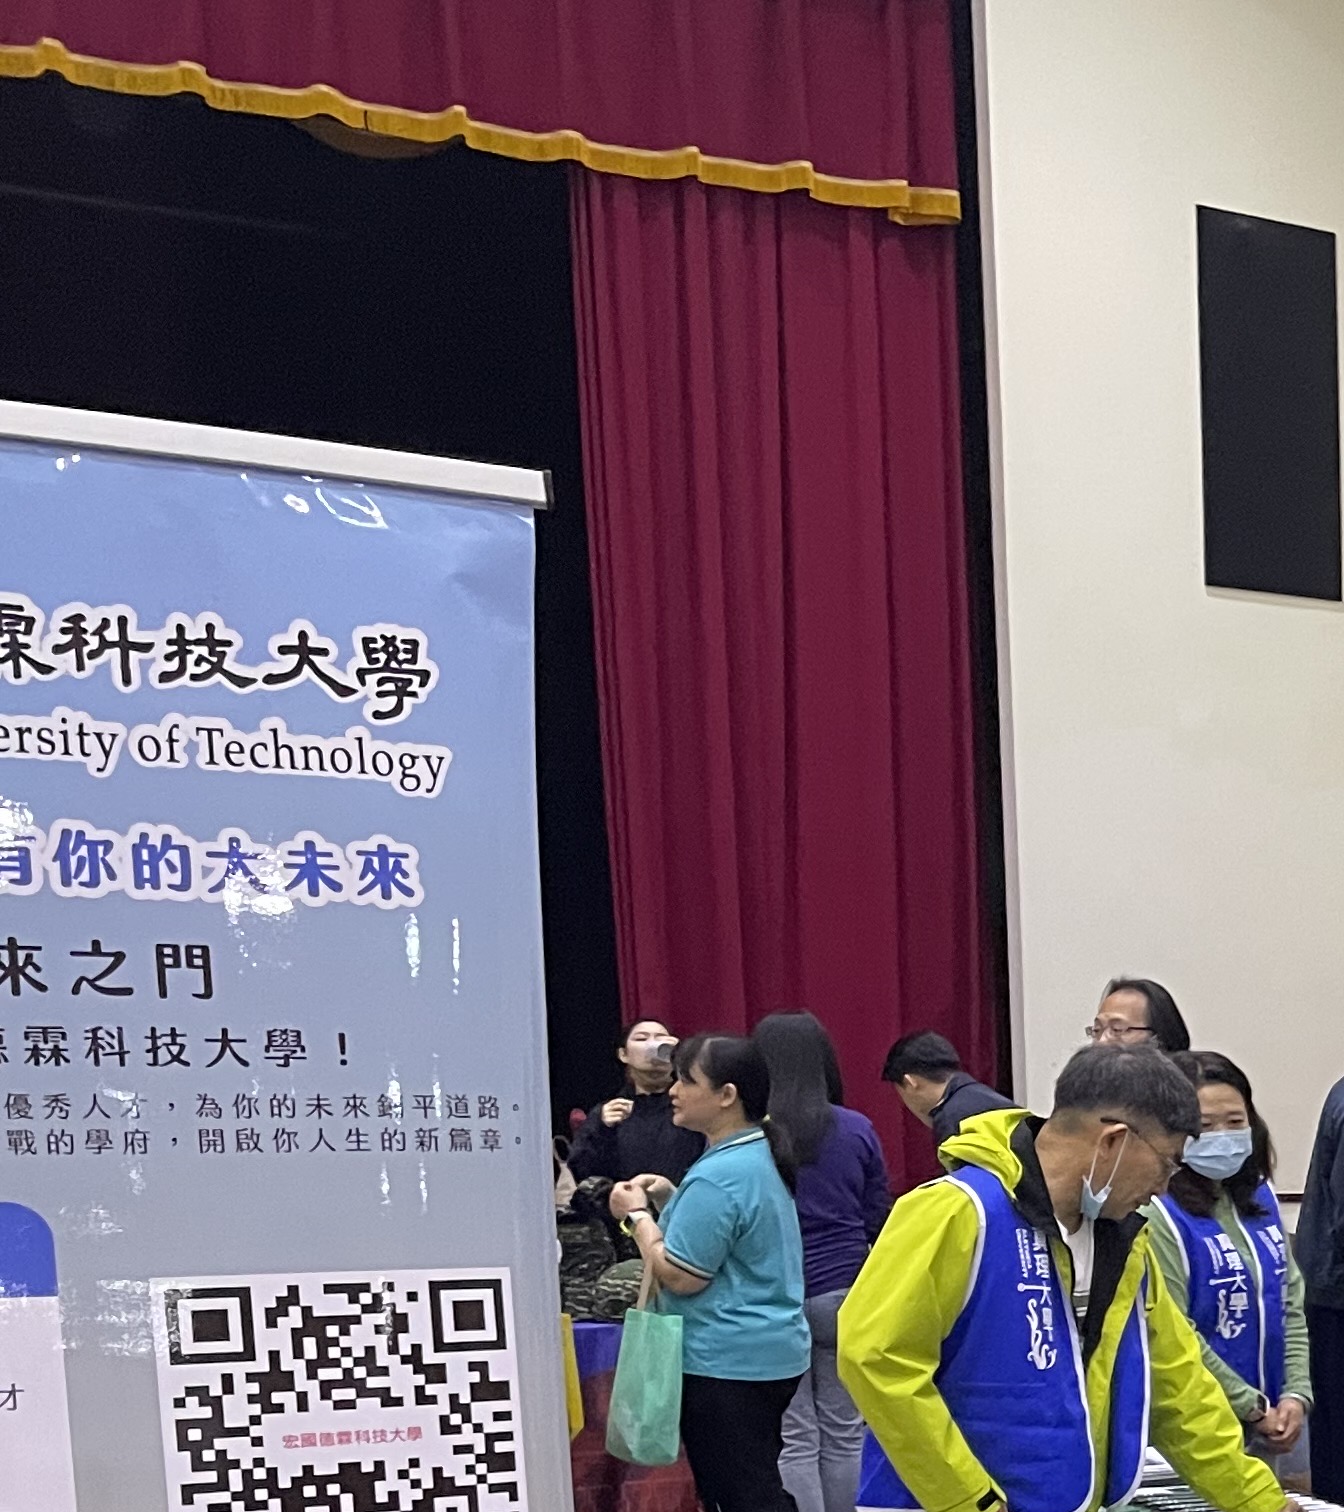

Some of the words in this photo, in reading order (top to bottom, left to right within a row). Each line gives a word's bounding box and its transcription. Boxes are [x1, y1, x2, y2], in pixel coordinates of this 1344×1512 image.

[136, 723, 181, 763] of
[195, 726, 446, 791] Technology
[0, 1025, 350, 1068] 霖科技大學！
[282, 1426, 423, 1449] 宏國德霖科技大學
